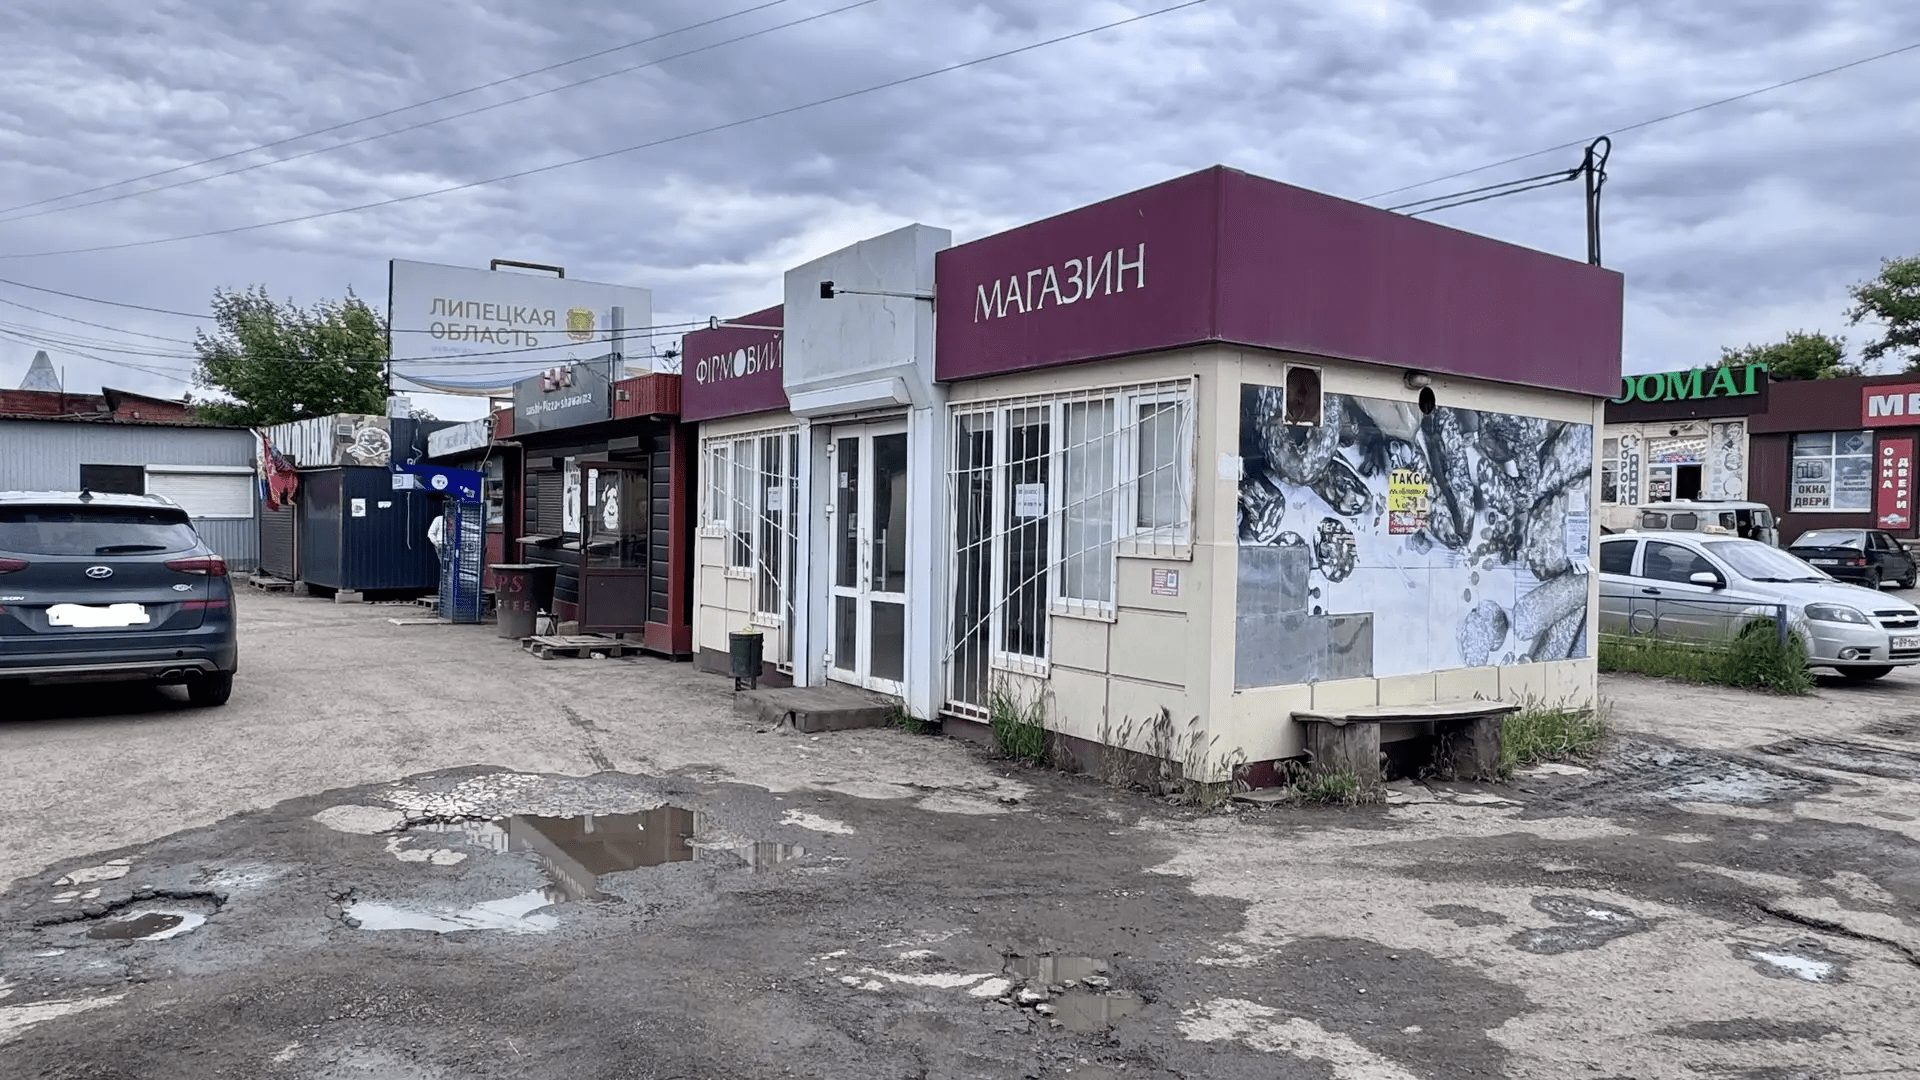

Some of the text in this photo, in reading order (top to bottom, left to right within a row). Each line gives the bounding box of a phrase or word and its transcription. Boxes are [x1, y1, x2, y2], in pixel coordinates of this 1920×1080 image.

[973, 242, 1146, 323] МАГАЗИН
[429, 297, 557, 328] ЛИПЕЦКАЯ
[429, 321, 539, 348] ОБЛАСТЬ
[695, 333, 783, 386] ФІРМОВИЙ
[1619, 434, 1630, 506] СОРОКА
[1881, 447, 1895, 489] ОКНА
[1896, 457, 1909, 509] ДВЕРИ
[1794, 497, 1830, 508] ДВЕРИ
[1798, 485, 1826, 494] ОКНА
